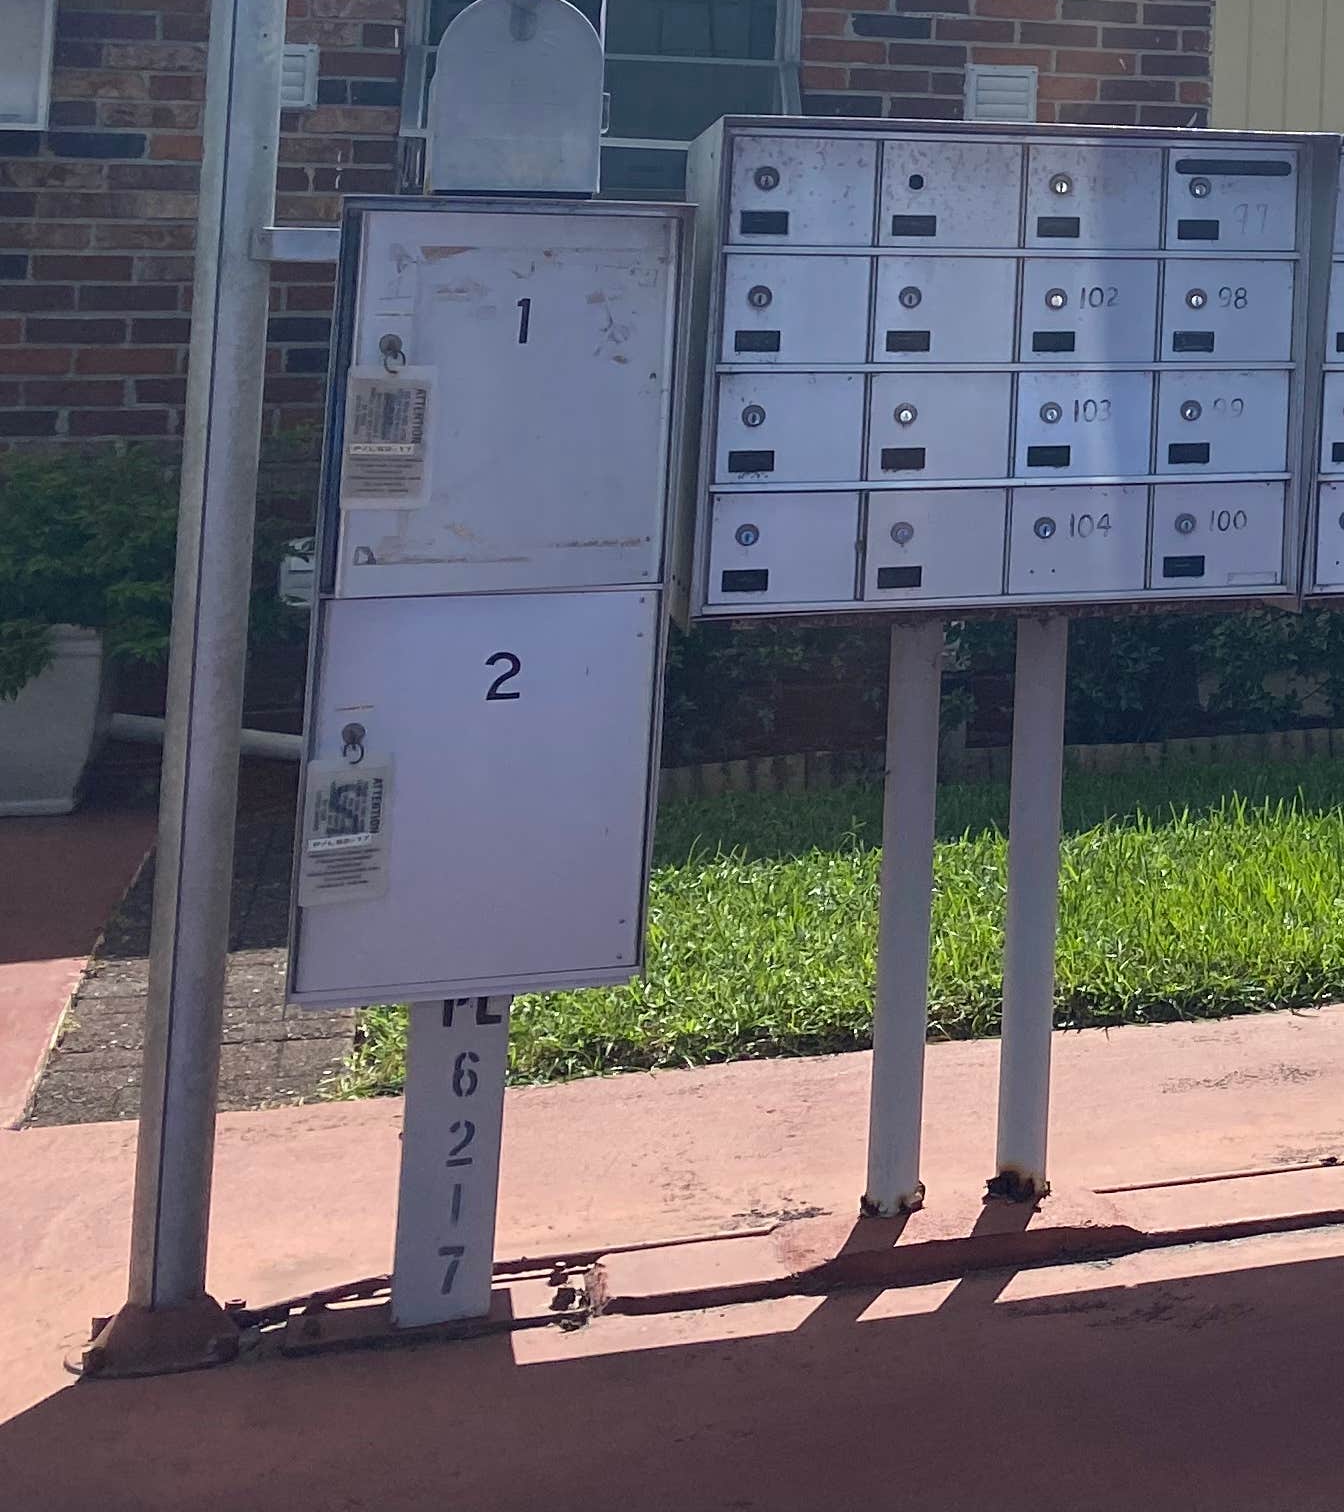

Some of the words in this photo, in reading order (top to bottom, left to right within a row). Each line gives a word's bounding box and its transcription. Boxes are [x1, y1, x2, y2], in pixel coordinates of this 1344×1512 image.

[1079, 286, 1119, 310] 102
[1218, 286, 1248, 310] 98
[516, 297, 531, 344] 1
[411, 388, 427, 444] ATTENTION
[1074, 399, 1112, 423] 103
[1069, 513, 1112, 538] 104
[1209, 509, 1248, 532] 100
[485, 651, 522, 702] 2
[369, 777, 383, 833] ATTENTION
